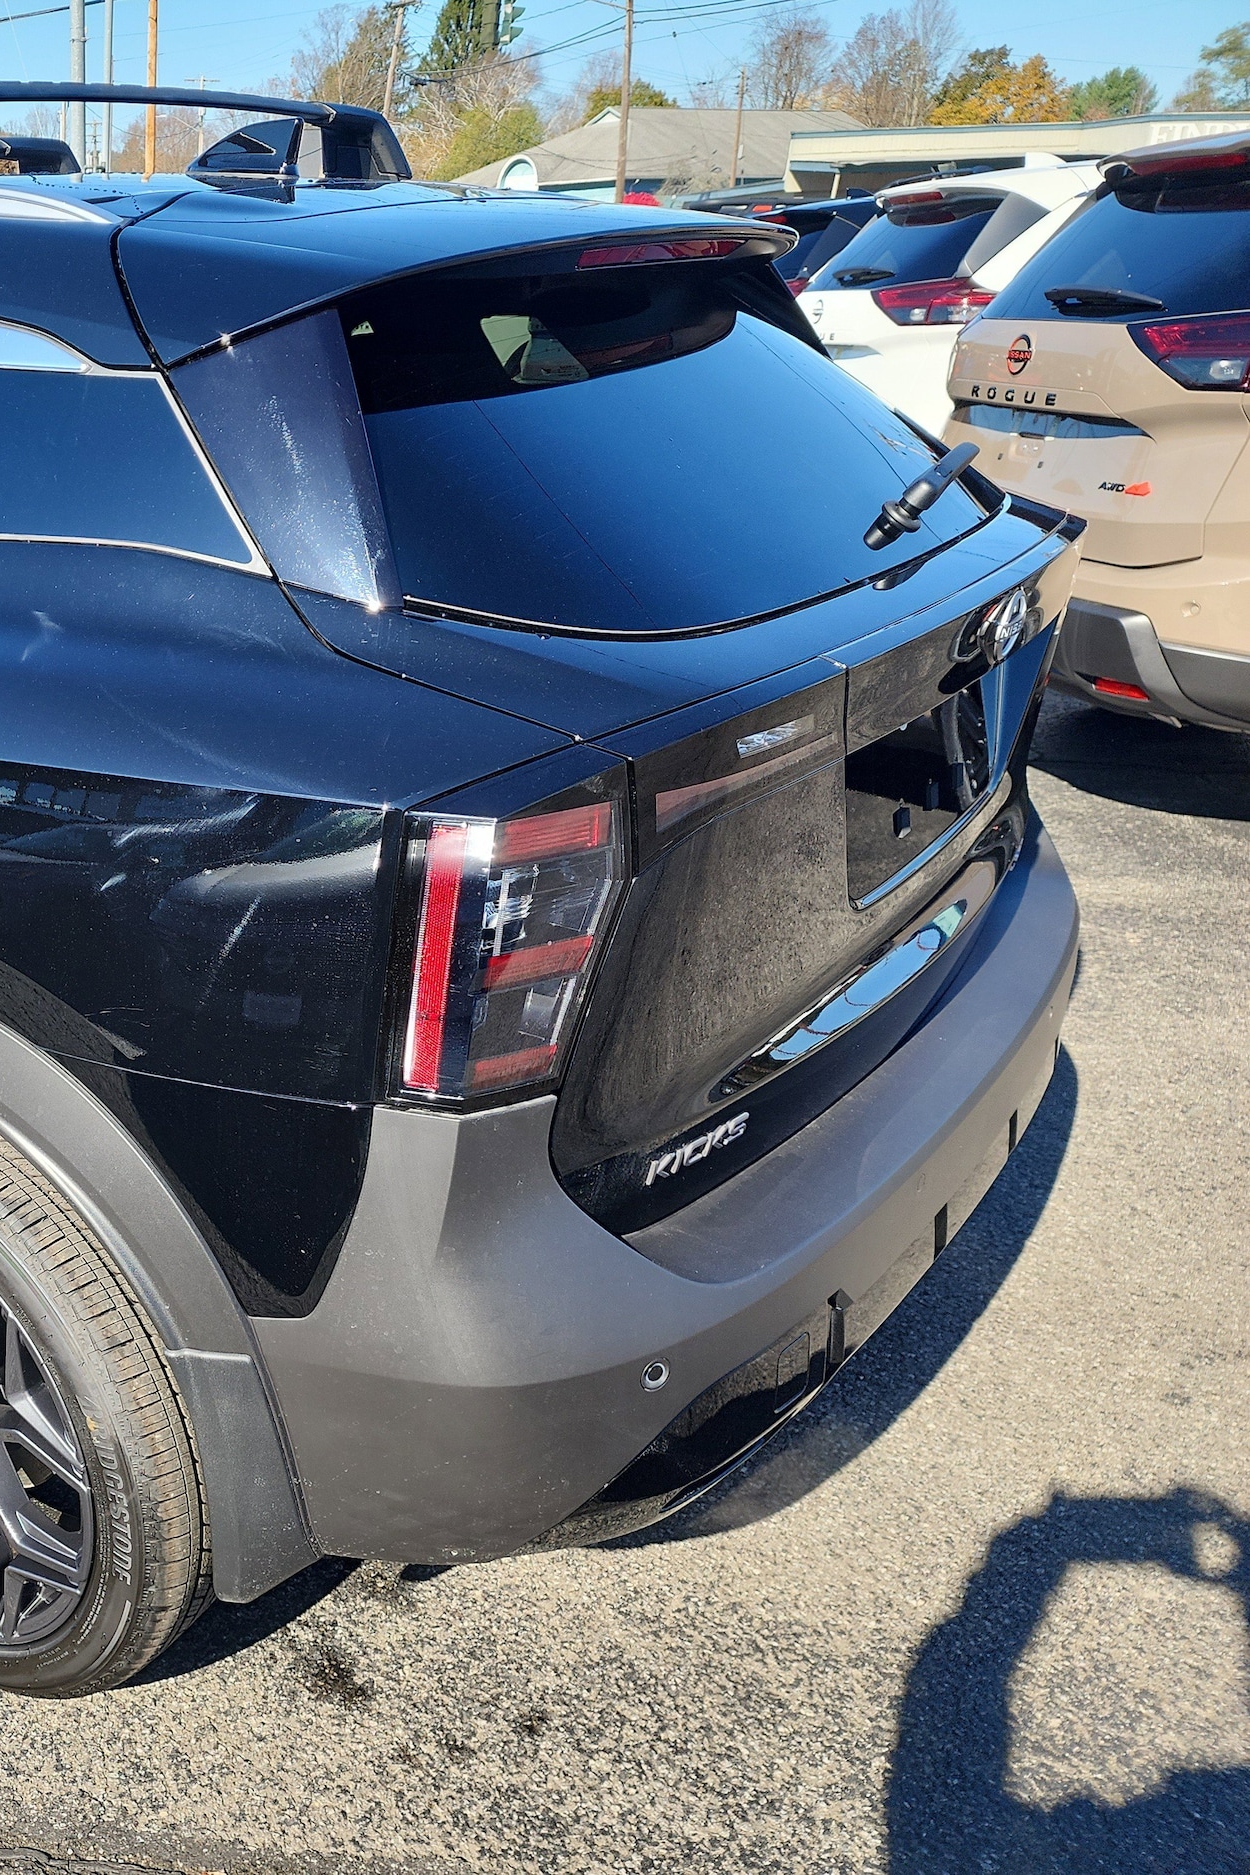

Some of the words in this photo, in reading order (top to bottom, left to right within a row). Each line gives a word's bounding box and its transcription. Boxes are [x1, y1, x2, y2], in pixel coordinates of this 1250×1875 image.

[971, 385, 1057, 406] ROGUE
[1098, 481, 1126, 493] AWD
[646, 1111, 750, 1186] KICKS
